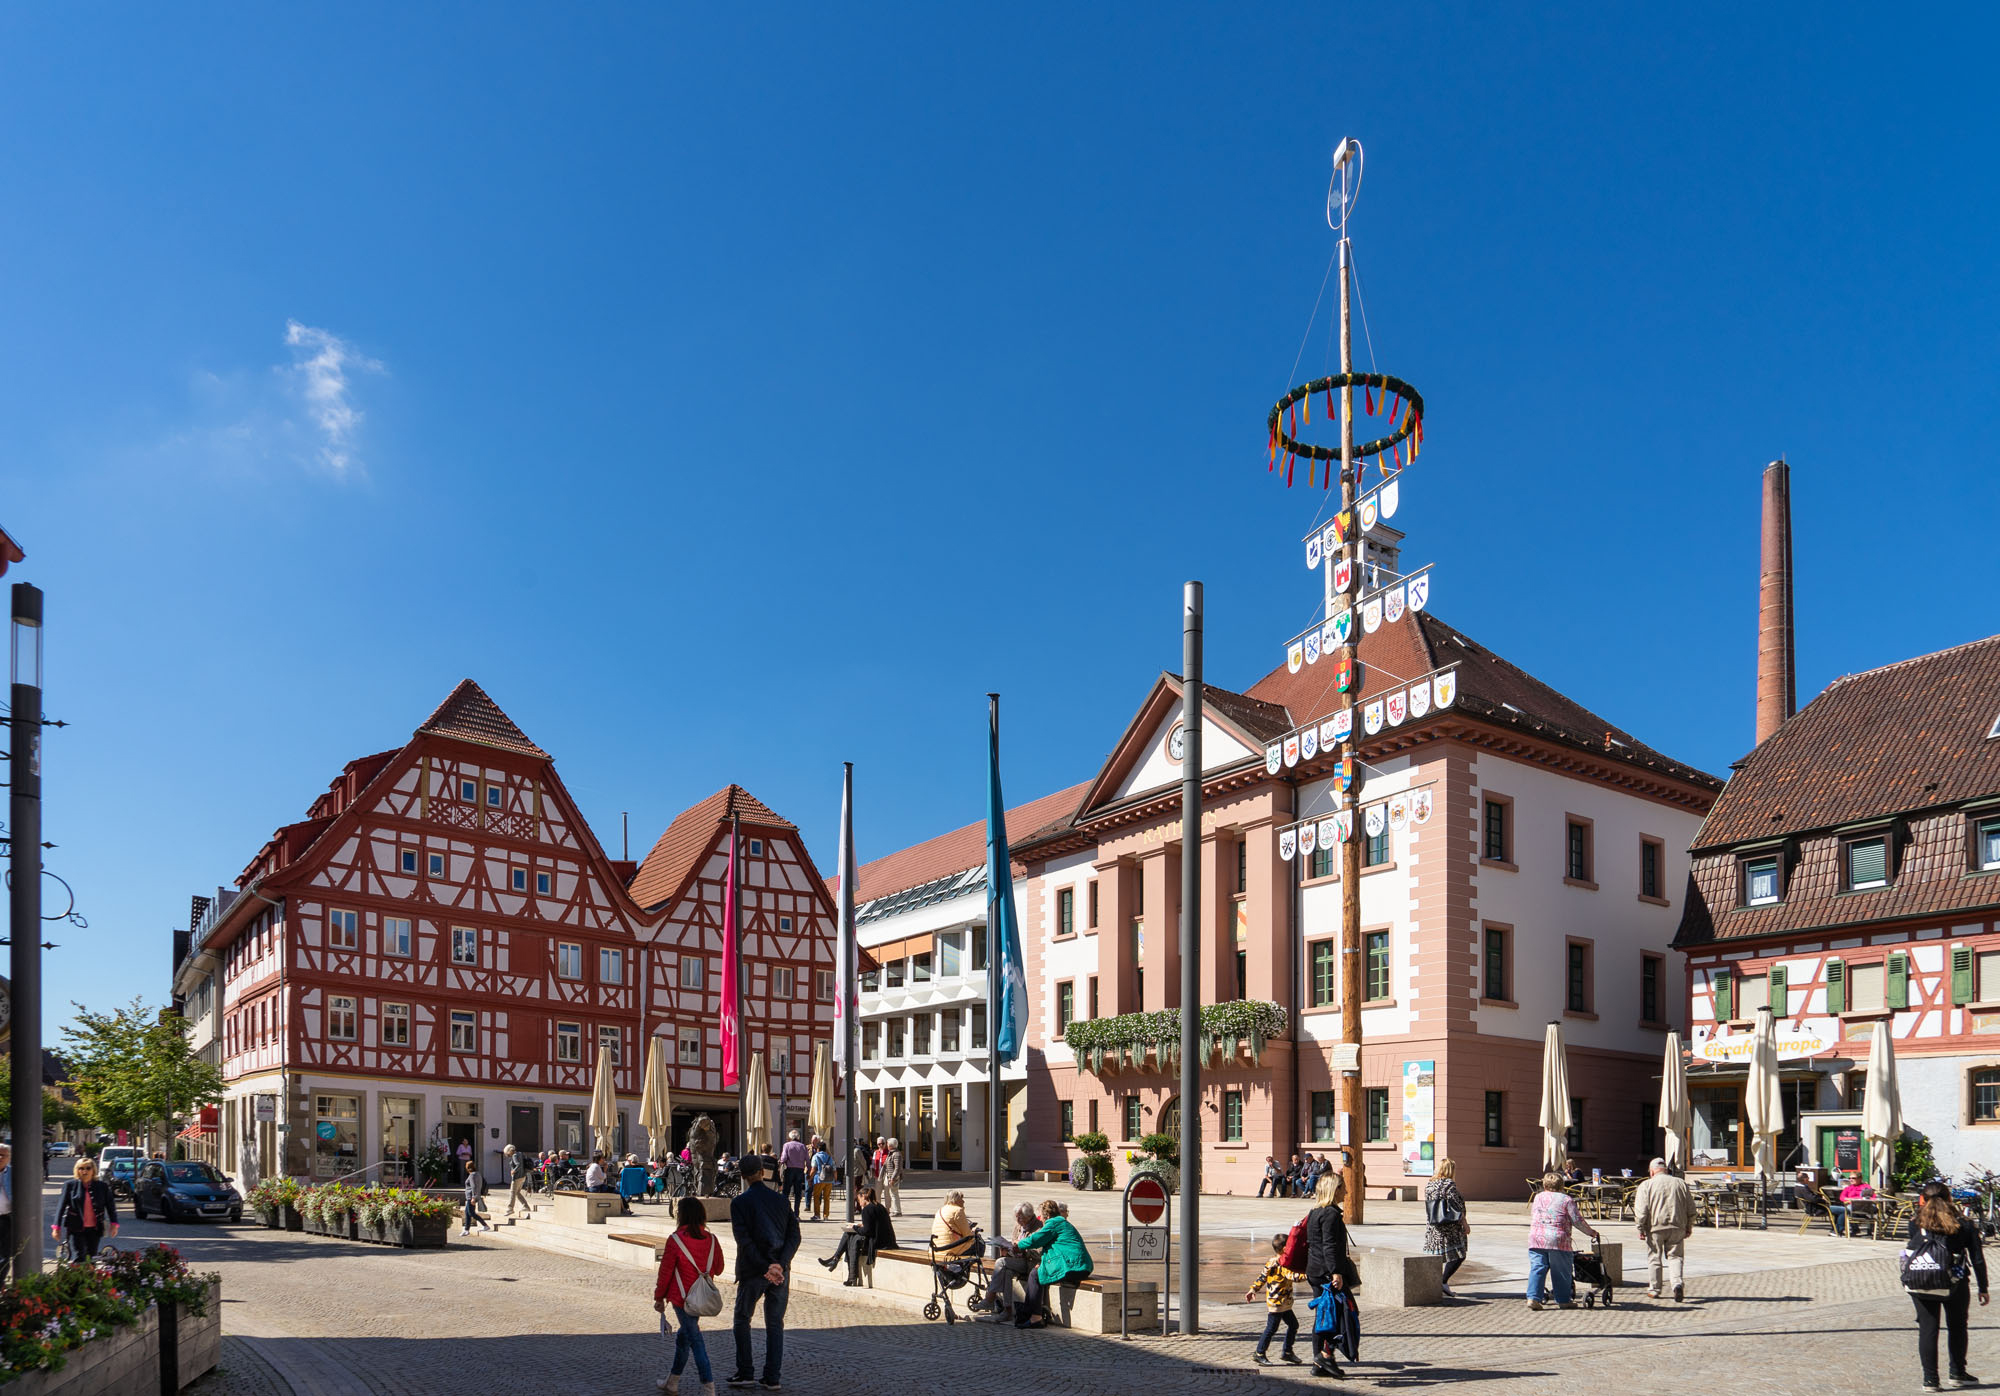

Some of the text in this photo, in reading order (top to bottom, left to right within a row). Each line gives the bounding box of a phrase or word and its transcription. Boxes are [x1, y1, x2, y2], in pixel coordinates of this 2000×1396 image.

[1, 1003, 9, 1015] 3
[1776, 1039, 1821, 1053] uropa
[1141, 1249, 1153, 1257] frei
[1909, 1263, 1941, 1271] adidas
